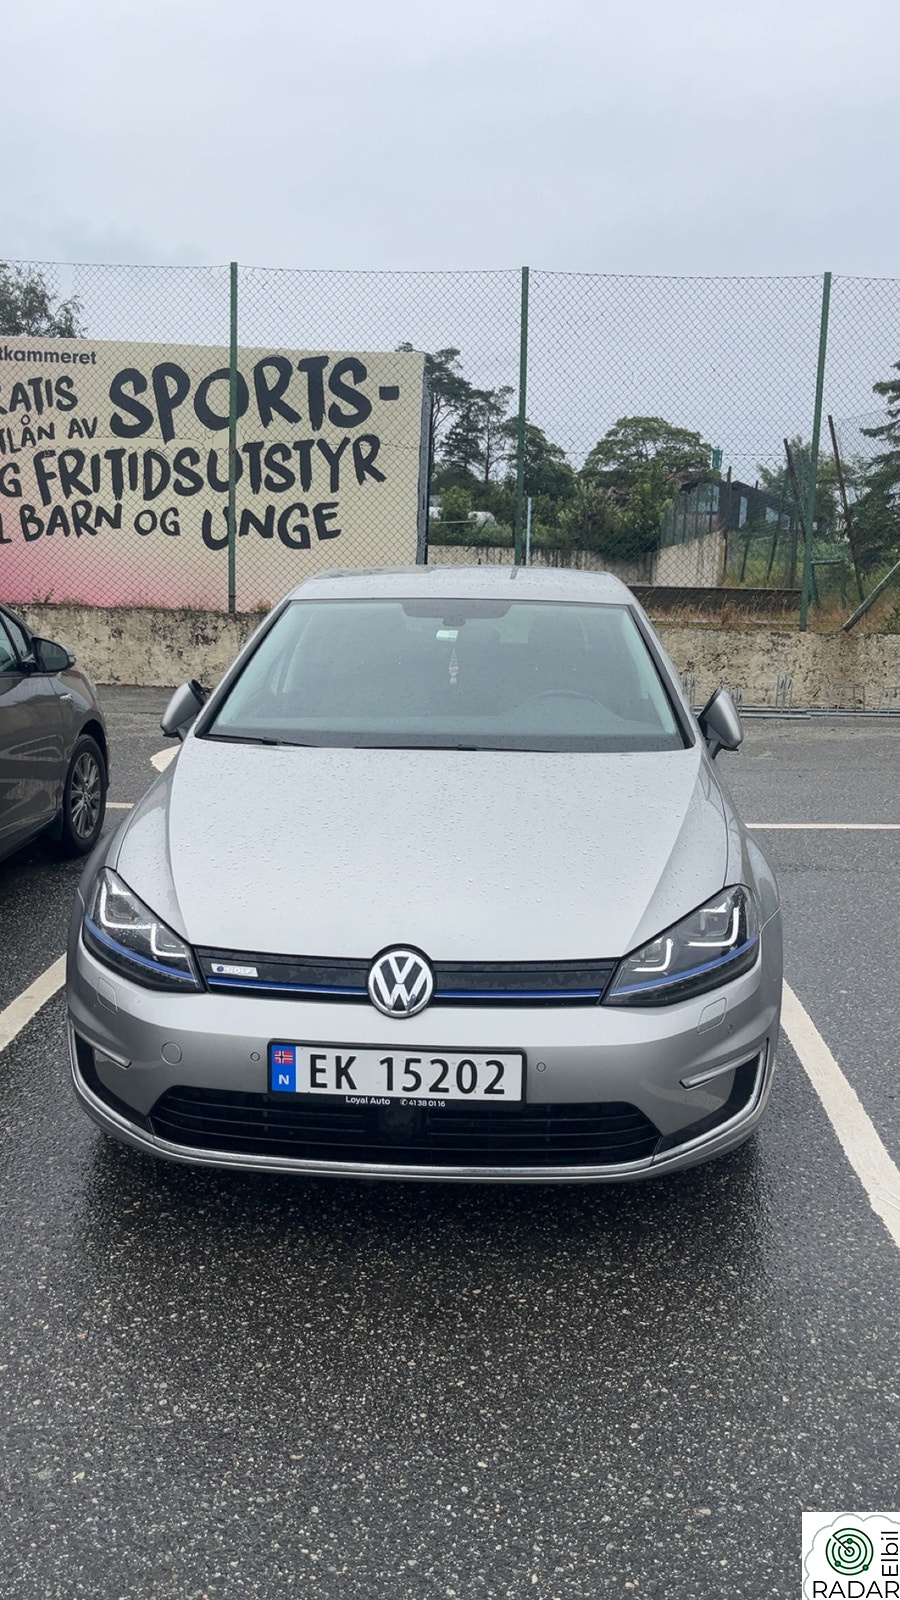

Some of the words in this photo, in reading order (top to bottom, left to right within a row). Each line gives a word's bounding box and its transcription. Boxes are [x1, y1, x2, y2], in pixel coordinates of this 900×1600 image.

[109, 355, 400, 444] SPORTS-
[68, 416, 98, 439] AV
[0, 462, 22, 497] G
[33, 434, 387, 507] FRITIDSUTSTYR
[20, 500, 122, 542] BARN
[134, 507, 180, 536] OG
[201, 502, 341, 551] UNGE
[278, 1074, 289, 1085] N
[310, 1054, 357, 1090] EK
[379, 1057, 505, 1095] 15202
[345, 1096, 368, 1105] Loyal
[370, 1097, 391, 1105] Auto
